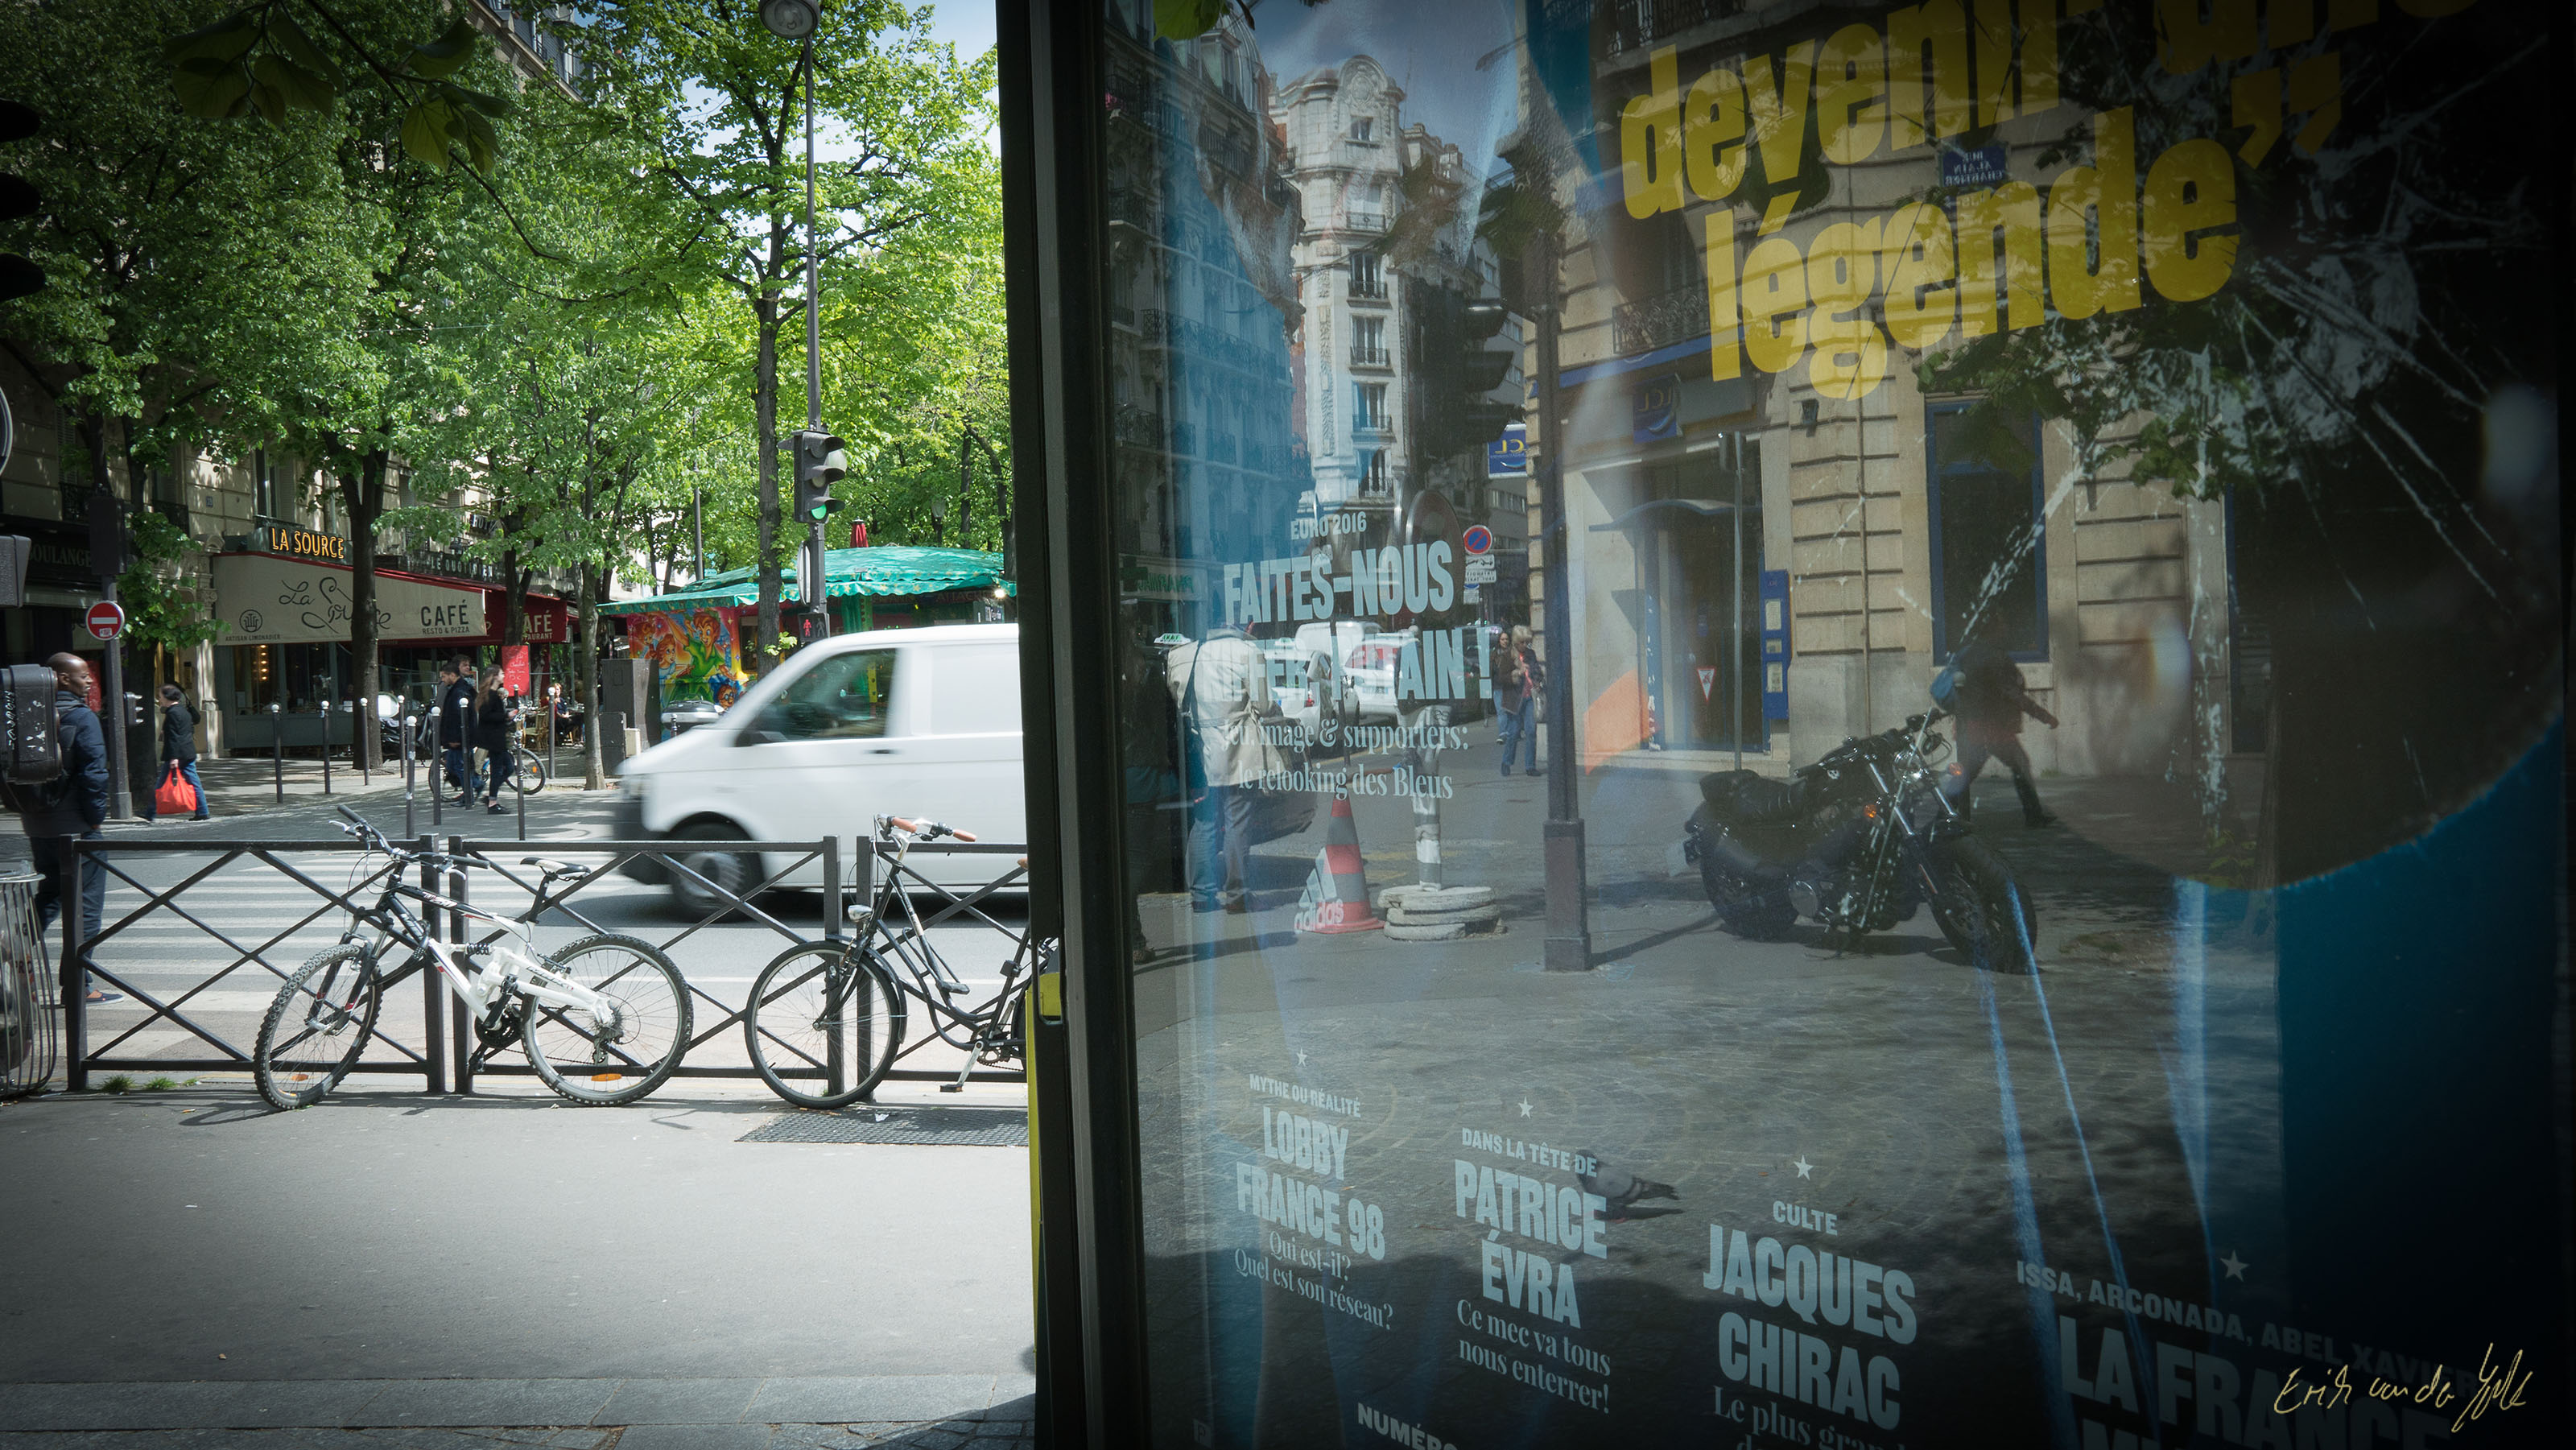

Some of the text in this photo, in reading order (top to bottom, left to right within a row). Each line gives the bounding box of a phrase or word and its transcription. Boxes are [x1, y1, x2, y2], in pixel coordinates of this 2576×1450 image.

[271, 527, 345, 559] LA SOURCE
[1290, 511, 1367, 540] EURO 2016
[279, 576, 391, 634] La Soue
[1224, 540, 1455, 626] FAITES-NOUS
[420, 599, 469, 626] CAFÉ
[451, 626, 470, 634] PIZZA
[522, 609, 553, 634] AFÉ
[1259, 716, 1315, 754] image
[1320, 718, 1340, 748] &
[1344, 721, 1469, 754] supporters:
[1237, 760, 1453, 801] le relooking des Bleus
[1294, 898, 1344, 934] adidas
[1249, 1072, 1361, 1118] MYTHE OU RÉALITÉ
[1262, 1105, 1349, 1181] LOBBY
[1462, 1127, 1598, 1179] DANS LA TÊTE DE
[1236, 1161, 1385, 1261] FRANCE 98
[1455, 1159, 1608, 1260] PATRICE
[1772, 1200, 1839, 1237] CULTE
[1269, 1230, 1352, 1282] Qui est-il?
[1481, 1229, 1582, 1329] ÉVRA
[1703, 1223, 1918, 1345] JACQUES
[1234, 1248, 1394, 1330] Quel est son réseau?
[2016, 1260, 2082, 1303] ISSA,
[2088, 1279, 2253, 1347] ARCONADA,
[2261, 1321, 2343, 1366] ABEL
[1456, 1299, 1611, 1378] Ce mec va tous
[2058, 1314, 2140, 1414] LA
[1459, 1338, 1610, 1415] nous enterrer!
[1718, 1311, 1901, 1431] CHIRAC
[1357, 1401, 1459, 1450] NUMÉR
[1713, 1385, 1745, 1424] Le
[1751, 1400, 1811, 1447] plus
